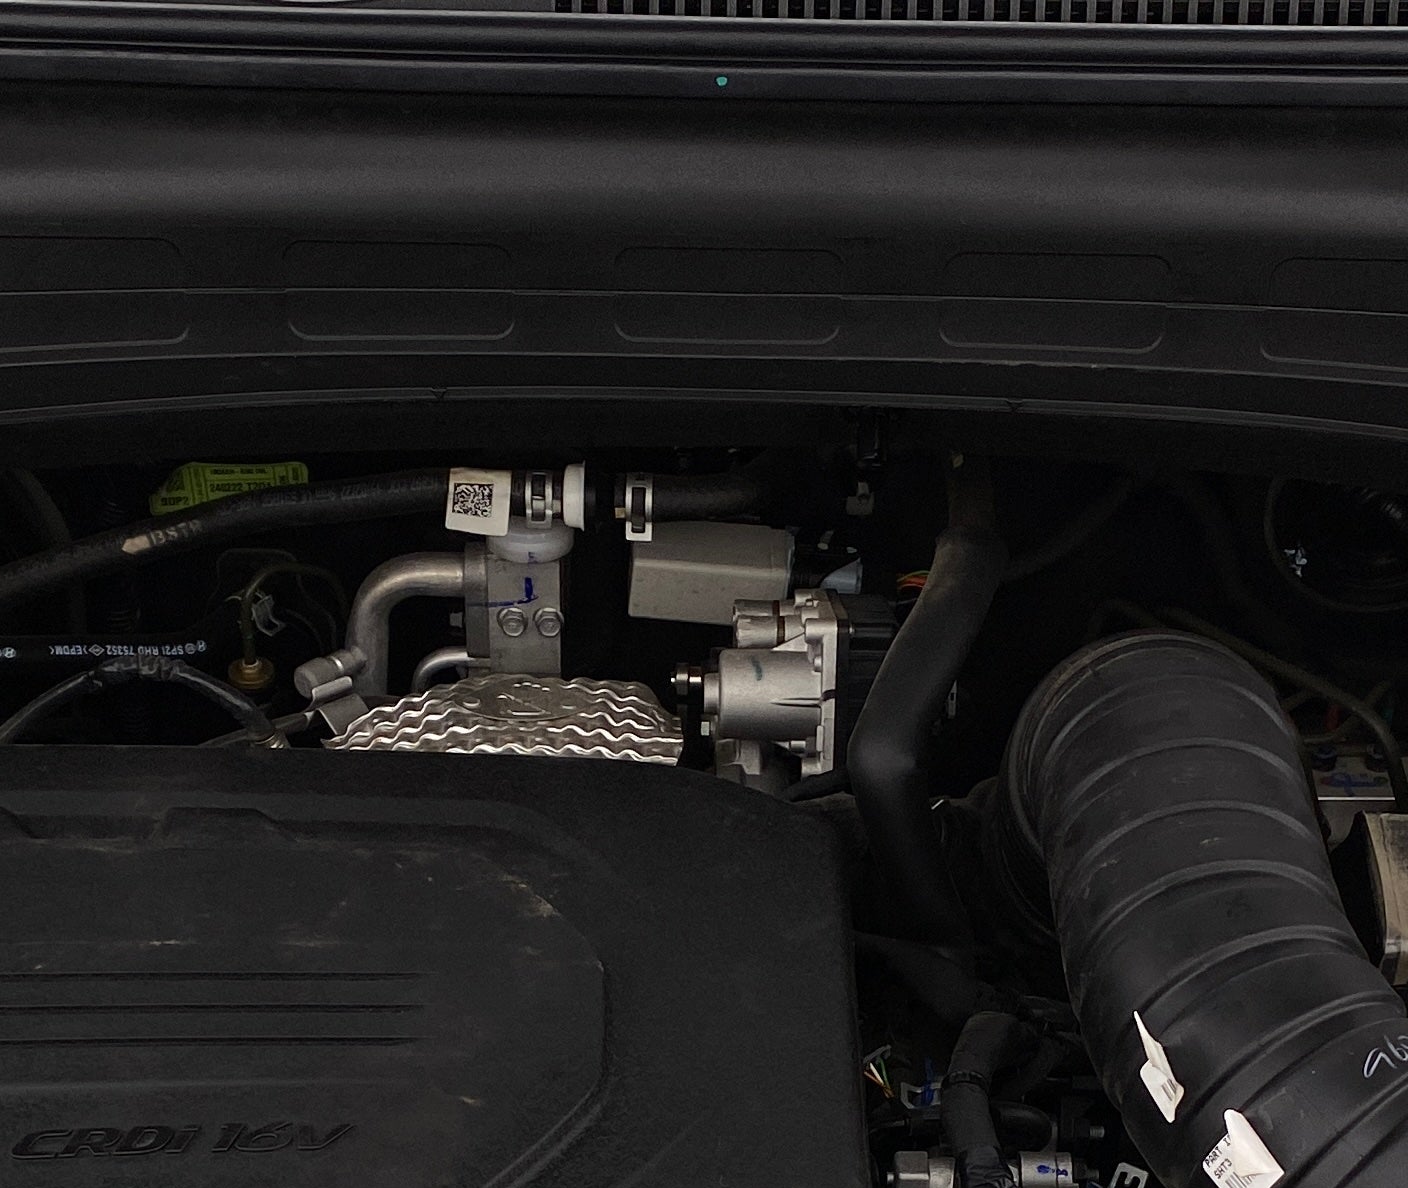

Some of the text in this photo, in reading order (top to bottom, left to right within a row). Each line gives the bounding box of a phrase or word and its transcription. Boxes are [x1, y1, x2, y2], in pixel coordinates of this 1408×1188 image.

[105, 645, 134, 656] 75352
[137, 645, 160, 656] RHD
[11, 1121, 356, 1160] CRDi 16V
[1204, 1146, 1223, 1168] PART
